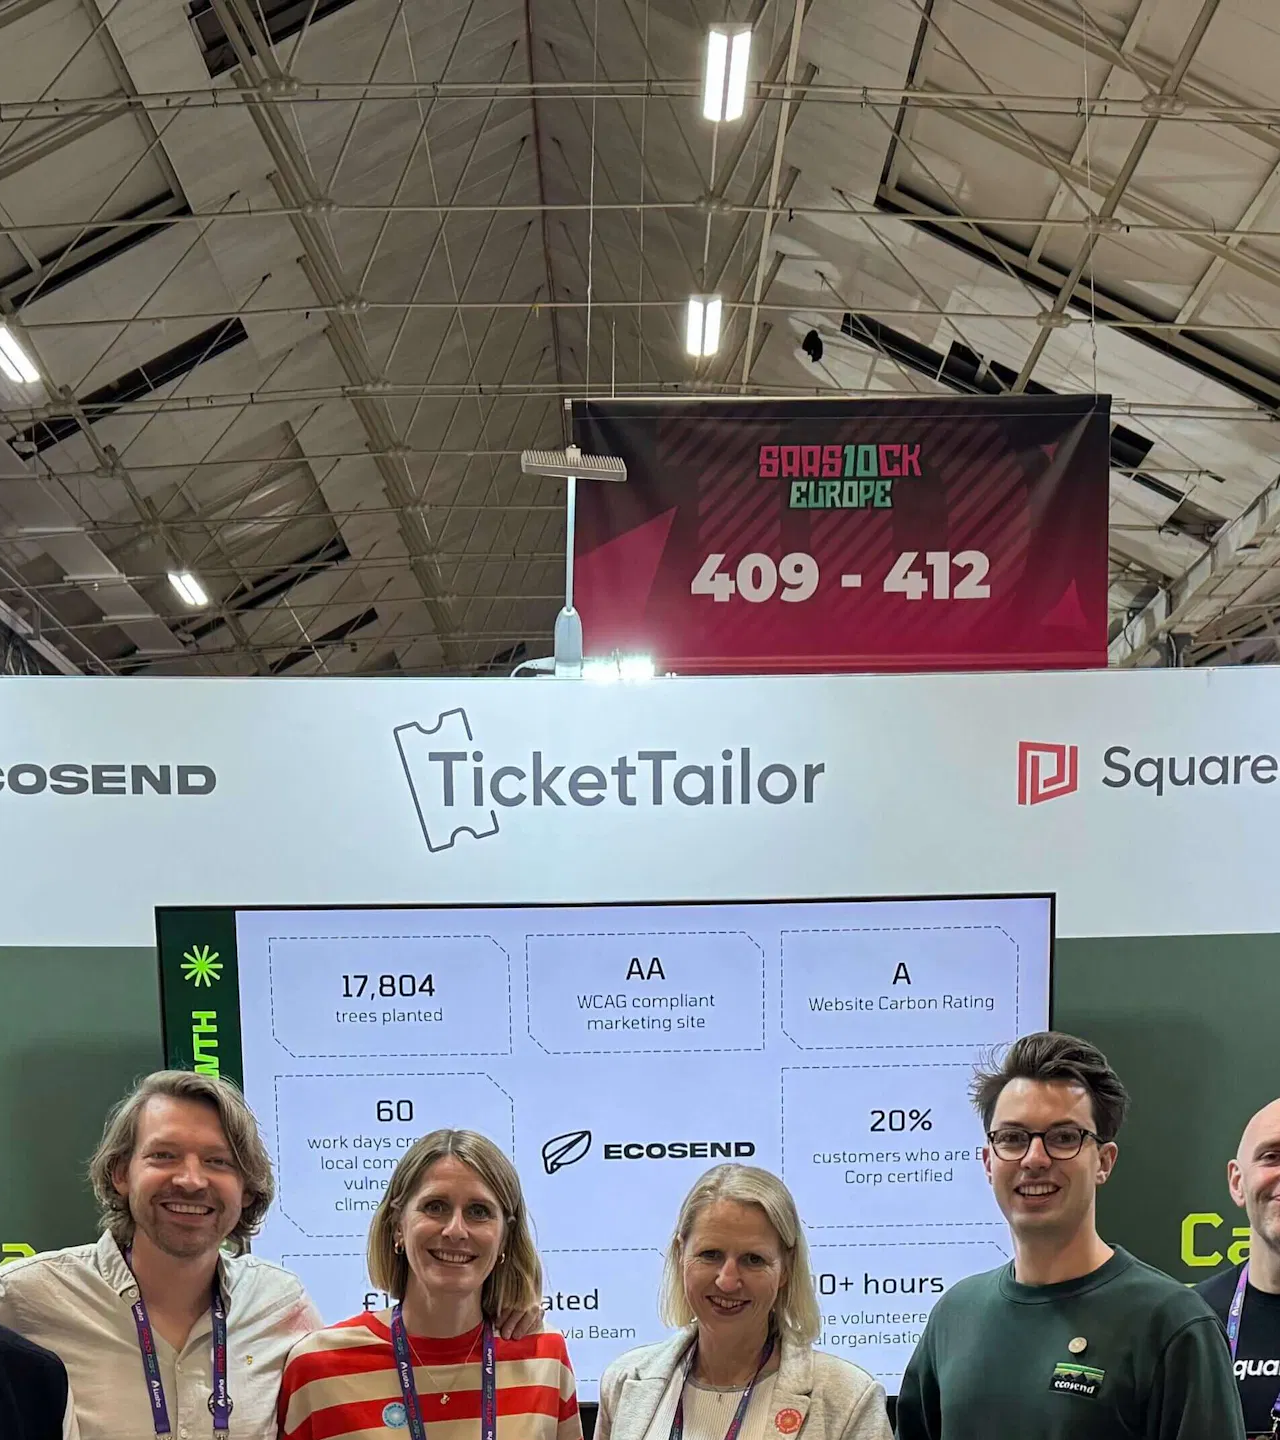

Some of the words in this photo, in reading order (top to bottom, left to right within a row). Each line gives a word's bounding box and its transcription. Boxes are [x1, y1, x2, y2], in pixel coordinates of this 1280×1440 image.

[789, 479, 892, 508] EUROPE
[691, 552, 819, 602] 409
[883, 550, 991, 600] 412
[428, 748, 826, 808] TicketTailor
[626, 957, 666, 981] AA
[892, 962, 912, 985] A
[342, 974, 436, 1000] 17,804
[577, 995, 628, 1009] WCAG
[632, 993, 716, 1011] compliant
[809, 997, 874, 1012] Website
[878, 996, 938, 1010] Carbon
[942, 995, 995, 1011] Rating
[336, 1010, 378, 1024] trees
[382, 1008, 444, 1026] planted
[587, 1016, 673, 1032] marketing
[677, 1016, 706, 1029] site
[376, 1100, 414, 1123] 60
[870, 1109, 933, 1133] 20%
[308, 1135, 349, 1149] work
[353, 1135, 392, 1153] days
[604, 1142, 756, 1160] ECOSEND
[321, 1156, 358, 1170] local
[813, 1150, 901, 1165] customers
[906, 1148, 941, 1162] who
[944, 1151, 970, 1162] are
[845, 1171, 883, 1187] Corp
[888, 1168, 954, 1184] certified
[812, 1273, 854, 1295] 0+
[864, 1273, 945, 1294] hours
[561, 1327, 584, 1339] via
[589, 1326, 636, 1339] Beam
[1054, 1380, 1095, 1394] ecosend
